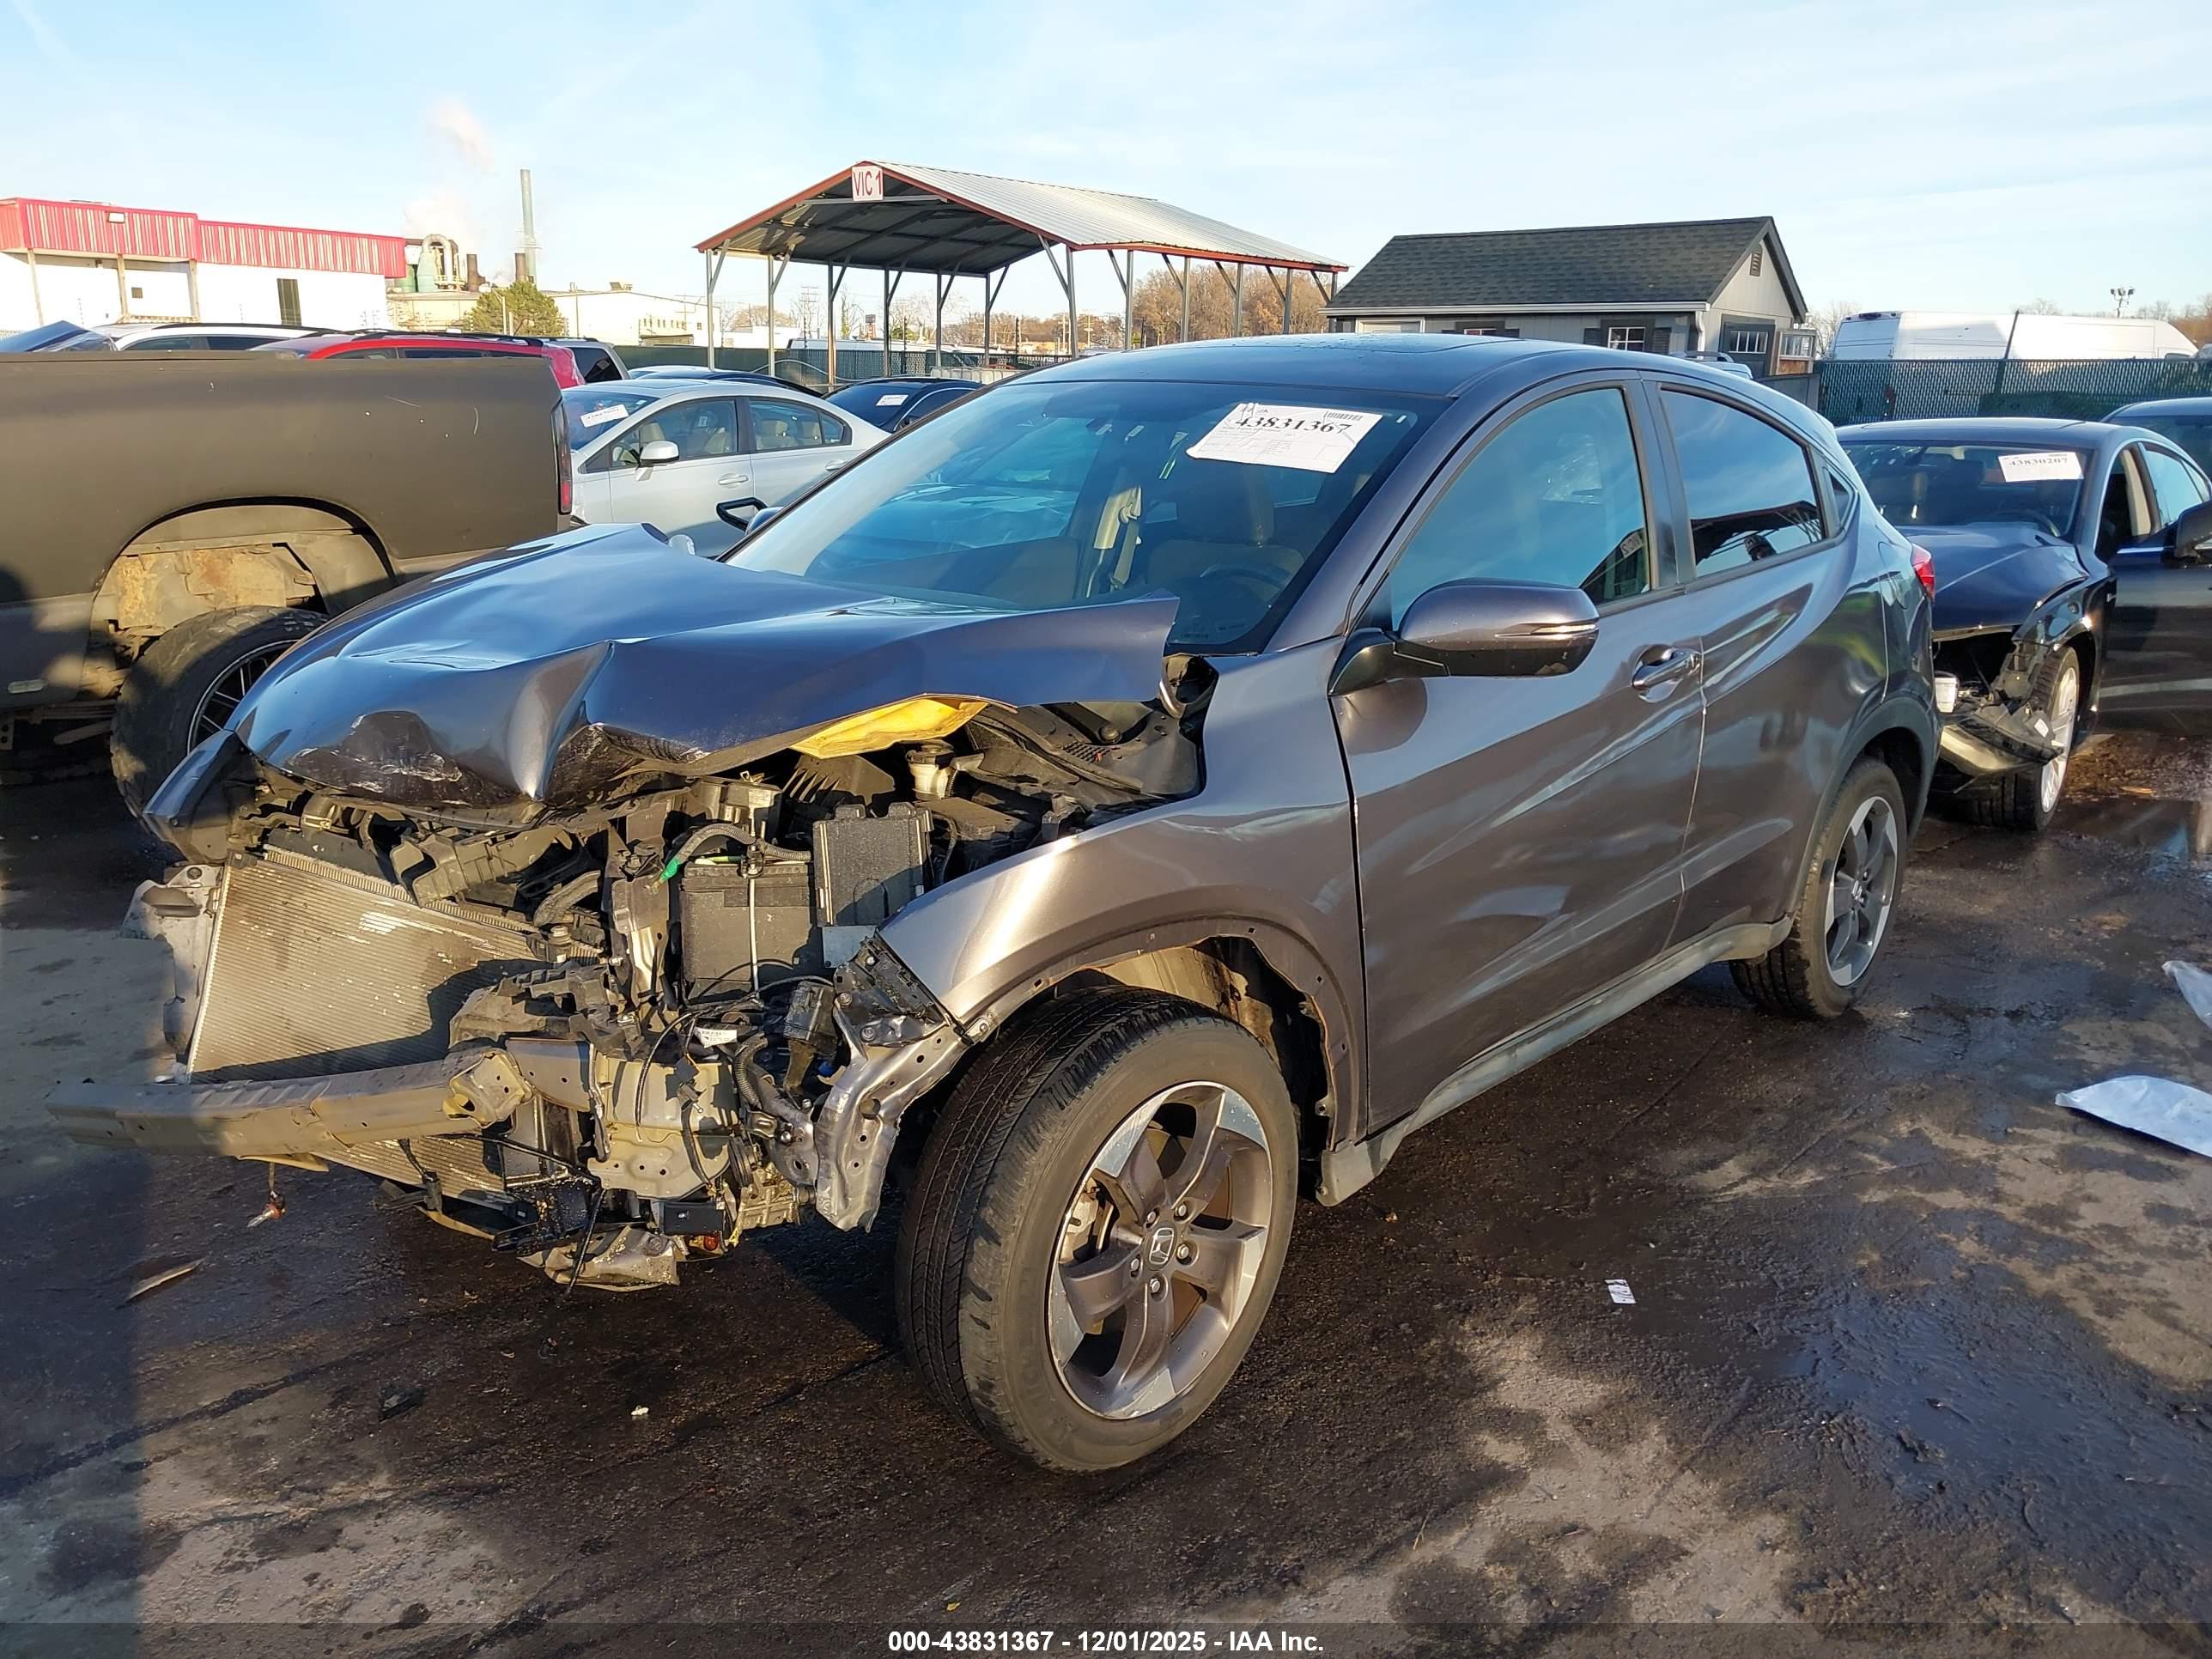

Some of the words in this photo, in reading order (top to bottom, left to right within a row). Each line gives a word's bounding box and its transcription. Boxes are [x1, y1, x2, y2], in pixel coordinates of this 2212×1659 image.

[853, 171, 872, 196] VIC
[875, 170, 882, 195] 1
[1235, 416, 1352, 434] 43831367
